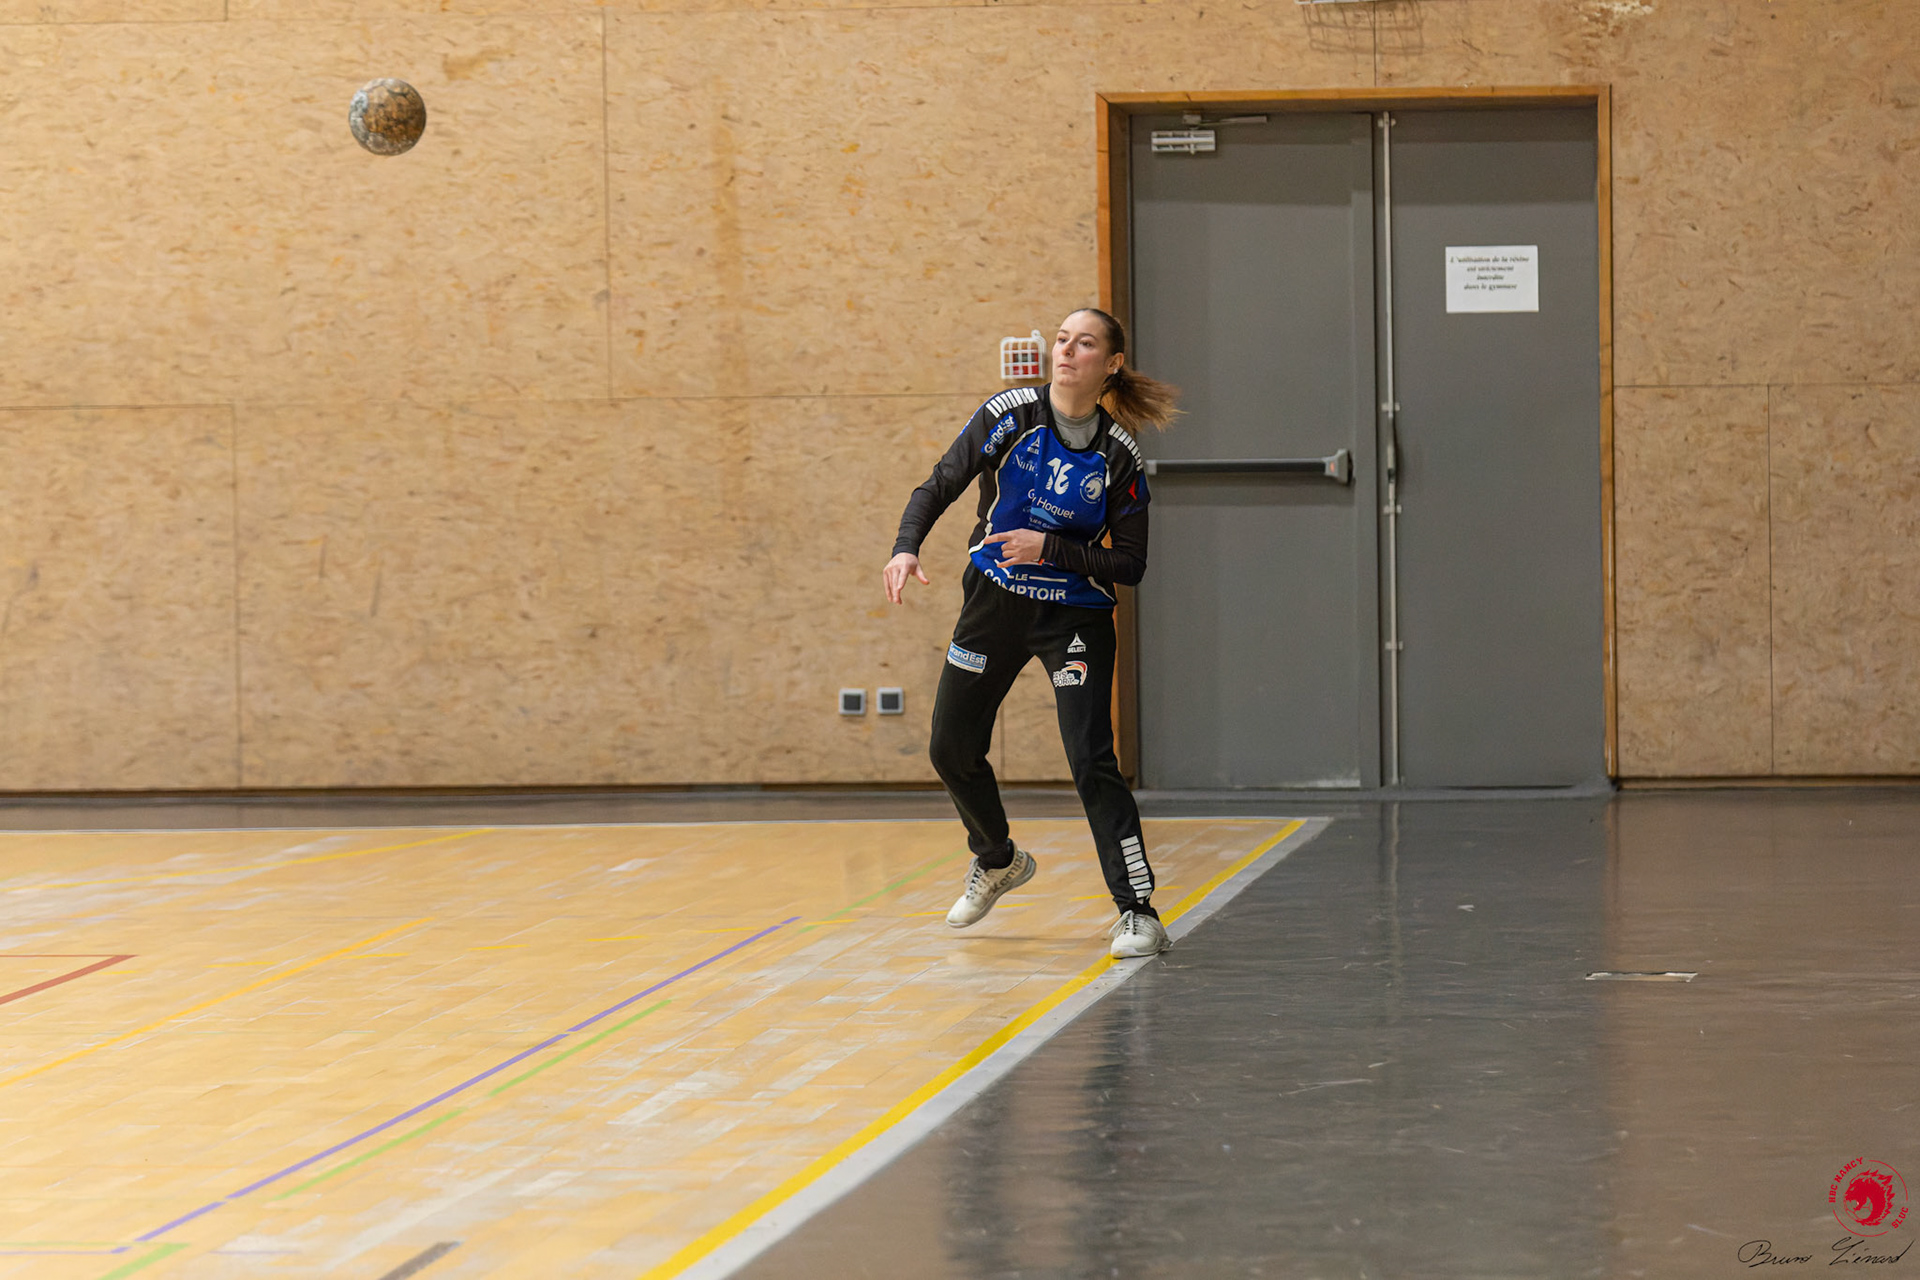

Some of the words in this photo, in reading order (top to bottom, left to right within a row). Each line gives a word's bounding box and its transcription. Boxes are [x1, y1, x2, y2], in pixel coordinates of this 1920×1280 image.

[1045, 457, 1074, 495] 16
[1036, 496, 1075, 519] Hoquet
[1015, 573, 1028, 581] LE
[1067, 646, 1086, 654] SELECT
